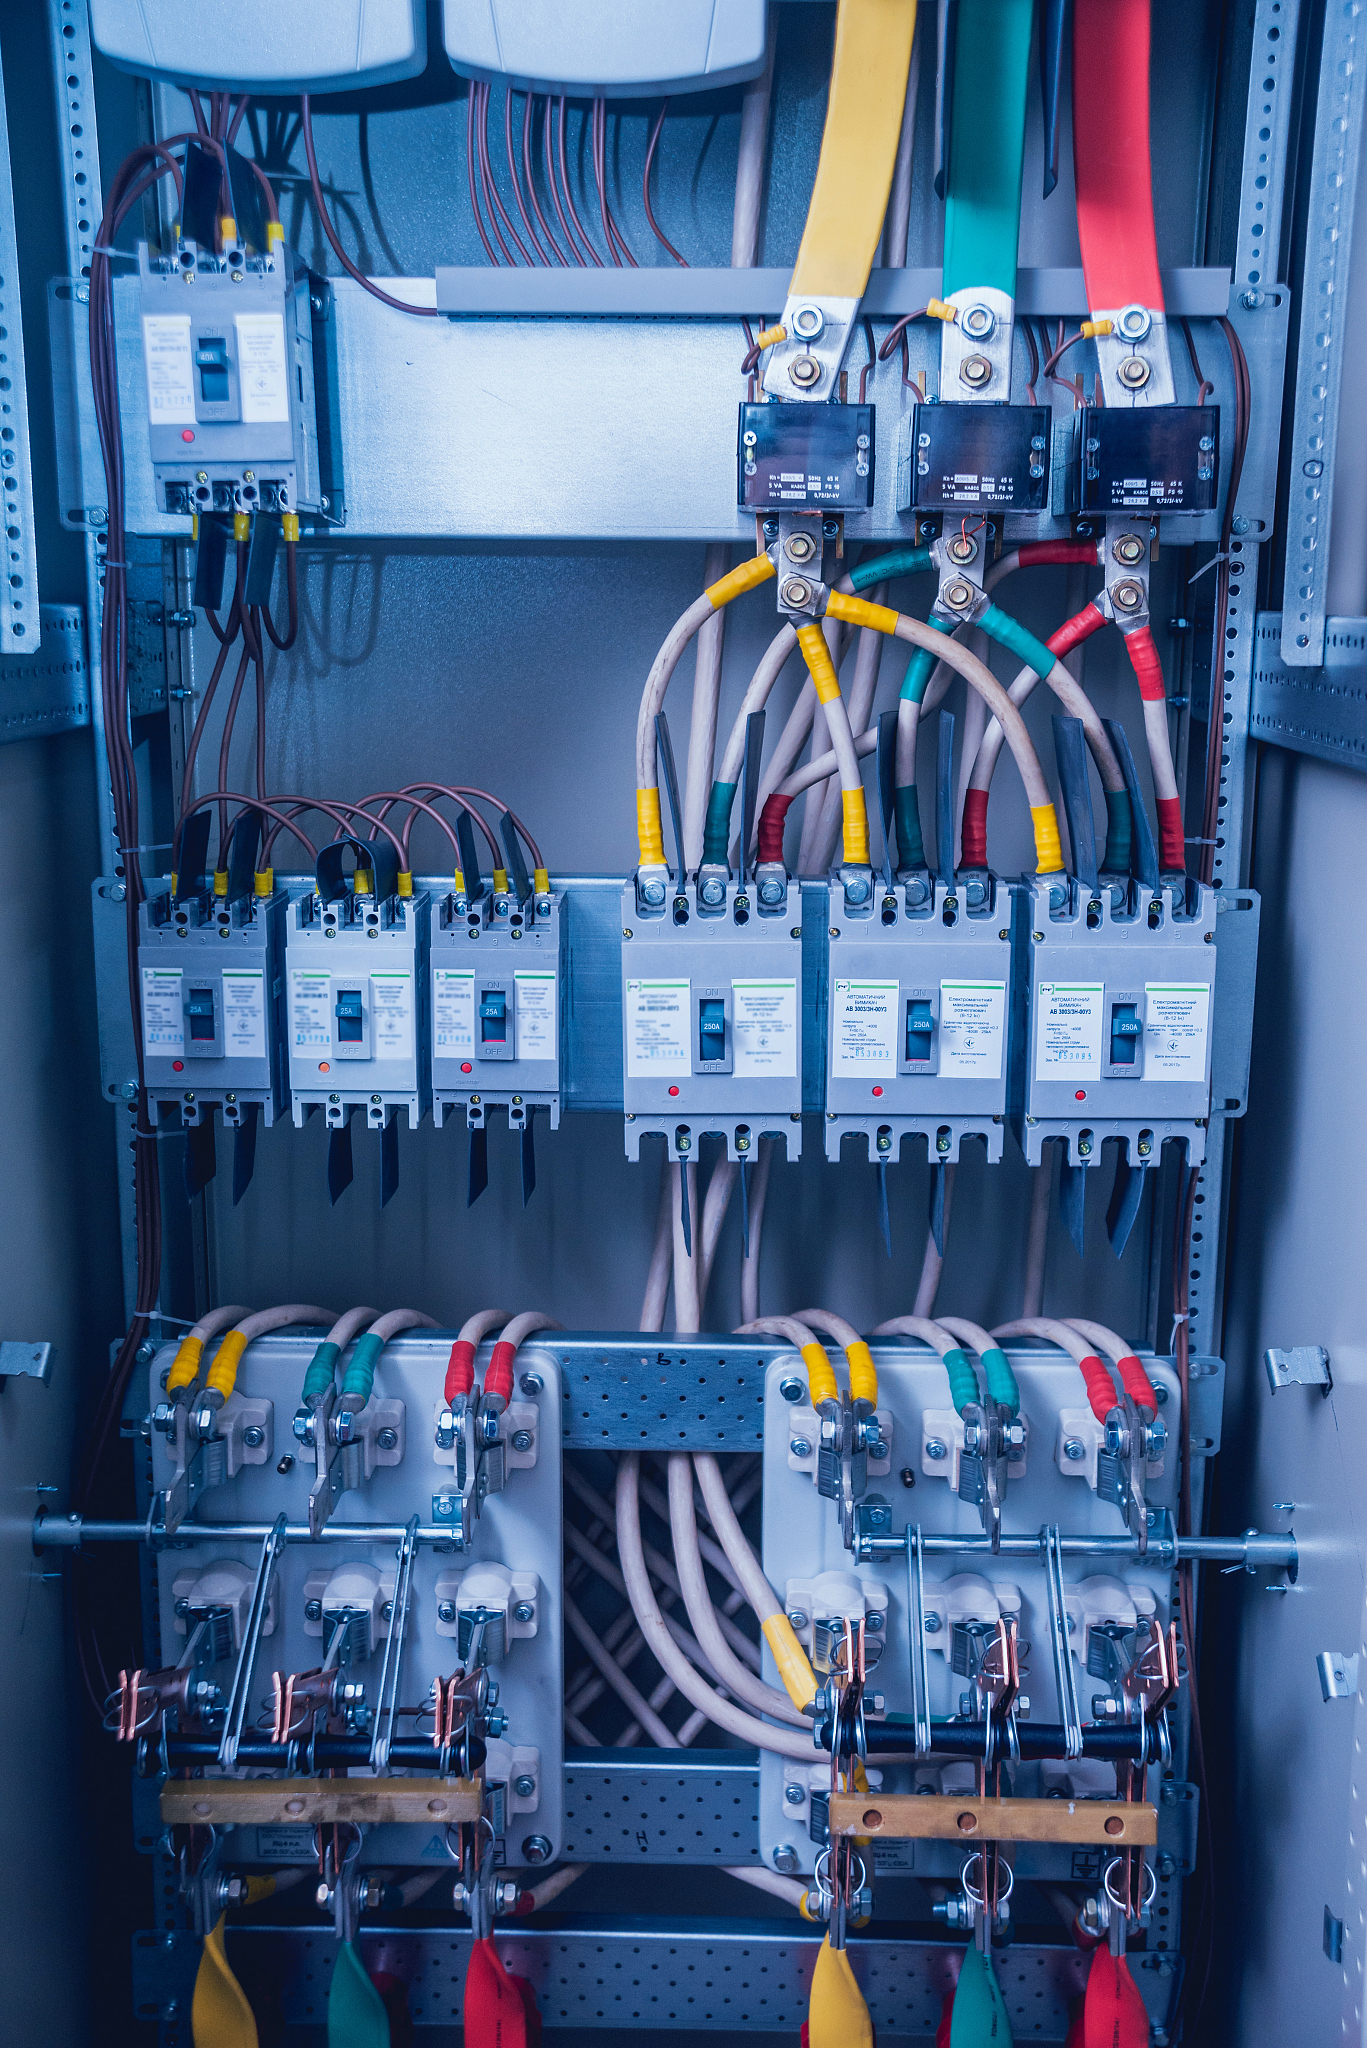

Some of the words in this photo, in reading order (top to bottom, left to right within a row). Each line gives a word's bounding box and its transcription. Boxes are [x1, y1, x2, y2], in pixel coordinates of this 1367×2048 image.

[204, 328, 219, 336] ON
[200, 354, 215, 362] 40A
[207, 408, 227, 417] OFF
[656, 925, 661, 935] 1
[707, 925, 715, 935] 3
[760, 925, 768, 935] 5
[864, 926, 869, 936] 1
[916, 926, 924, 936] 3
[969, 926, 977, 936] 5
[1069, 928, 1074, 939] 1
[1120, 928, 1129, 940] 3
[1174, 929, 1182, 939] 5
[194, 980, 207, 988] ON
[342, 981, 356, 989] ON
[487, 981, 500, 989] ON
[705, 988, 719, 997] ON
[912, 988, 927, 997] ON
[1118, 992, 1132, 1001] ON
[189, 1005, 203, 1014] 25A
[340, 1007, 353, 1015] 25A
[485, 1008, 498, 1016] 25A
[1121, 1023, 1138, 1031] 250A
[195, 1046, 212, 1054] OFF
[342, 1047, 360, 1056] OFF
[485, 1048, 503, 1056] OFF
[703, 1063, 722, 1072] OFF
[1112, 1067, 1132, 1076] OFF
[658, 1118, 666, 1127] 2
[708, 1117, 716, 1127] 4
[860, 1117, 868, 1128] 2
[911, 1118, 918, 1127] 4
[962, 1118, 970, 1128] 6
[1061, 1122, 1070, 1131] 2
[1112, 1122, 1120, 1131] 4
